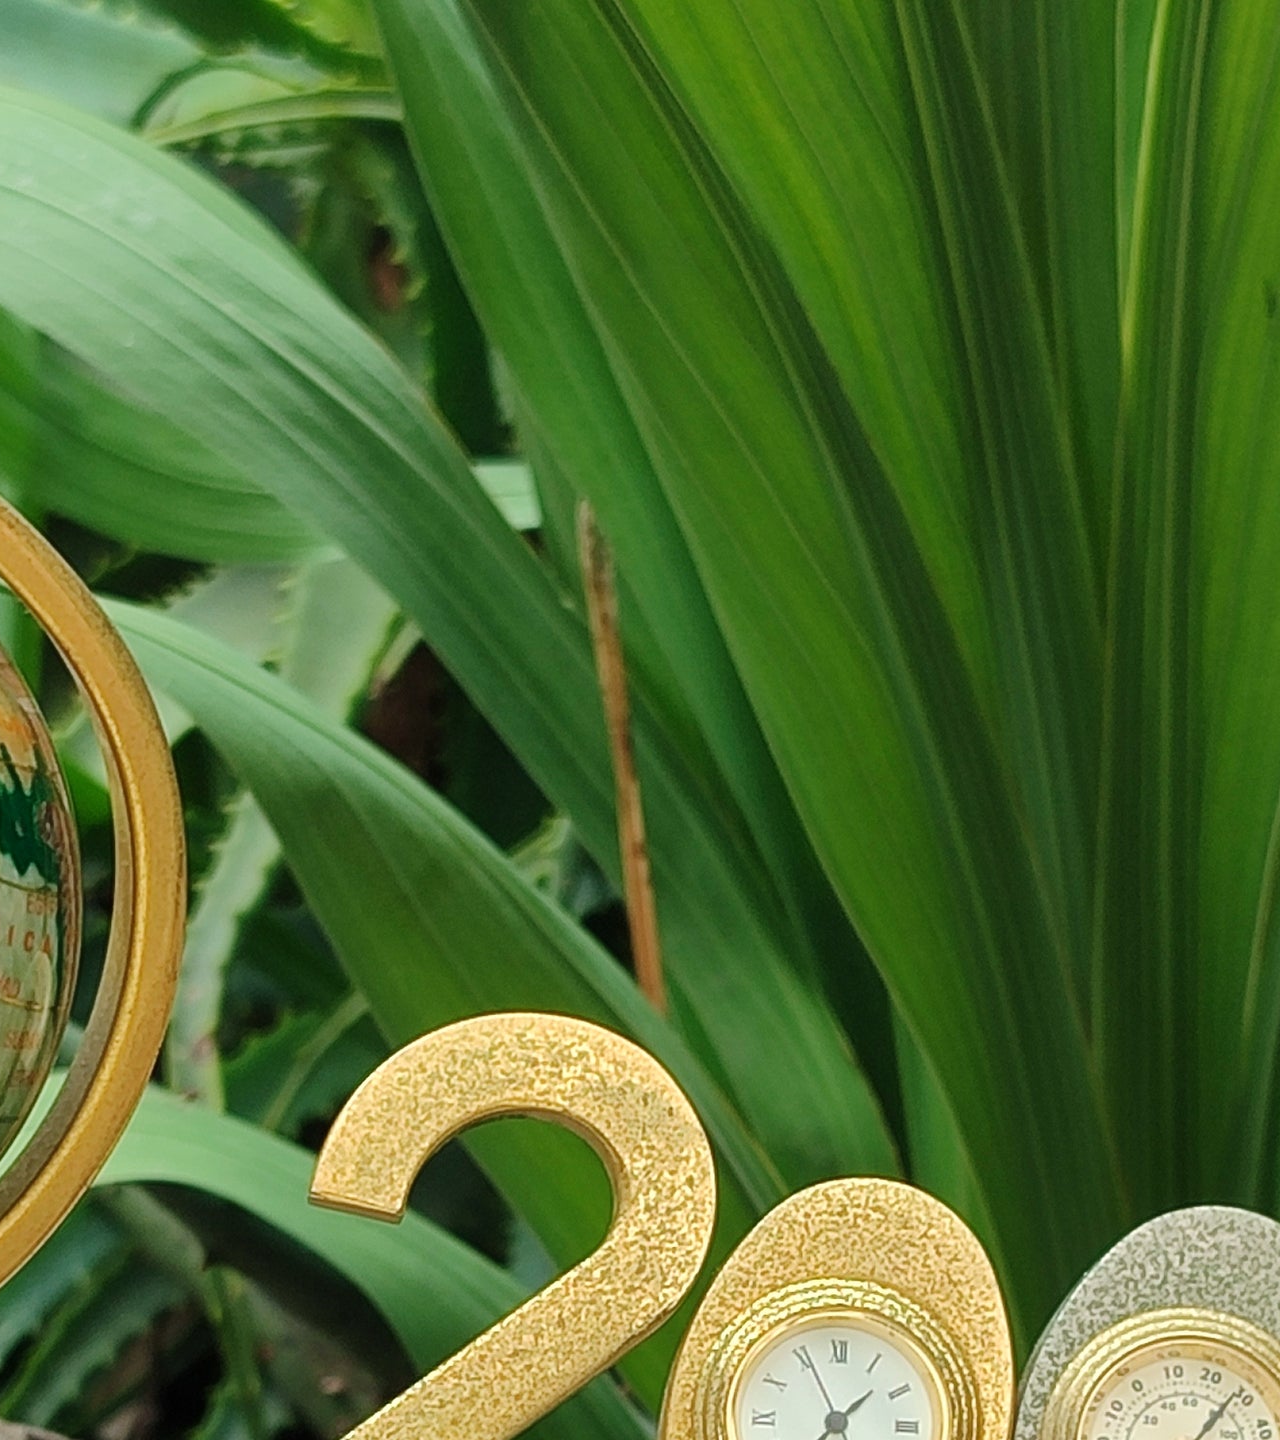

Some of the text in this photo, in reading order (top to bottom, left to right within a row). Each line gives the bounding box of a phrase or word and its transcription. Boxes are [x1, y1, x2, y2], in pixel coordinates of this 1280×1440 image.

[829, 1339, 848, 1364] XII
[1163, 1365, 1183, 1379] 10
[1200, 1367, 1222, 1384] 20
[763, 1373, 787, 1392] X
[1131, 1379, 1143, 1392] 0
[1235, 1386, 1254, 1407] 30
[752, 1408, 776, 1426] IX
[895, 1420, 919, 1434] III
[1256, 1418, 1272, 1440] 40
